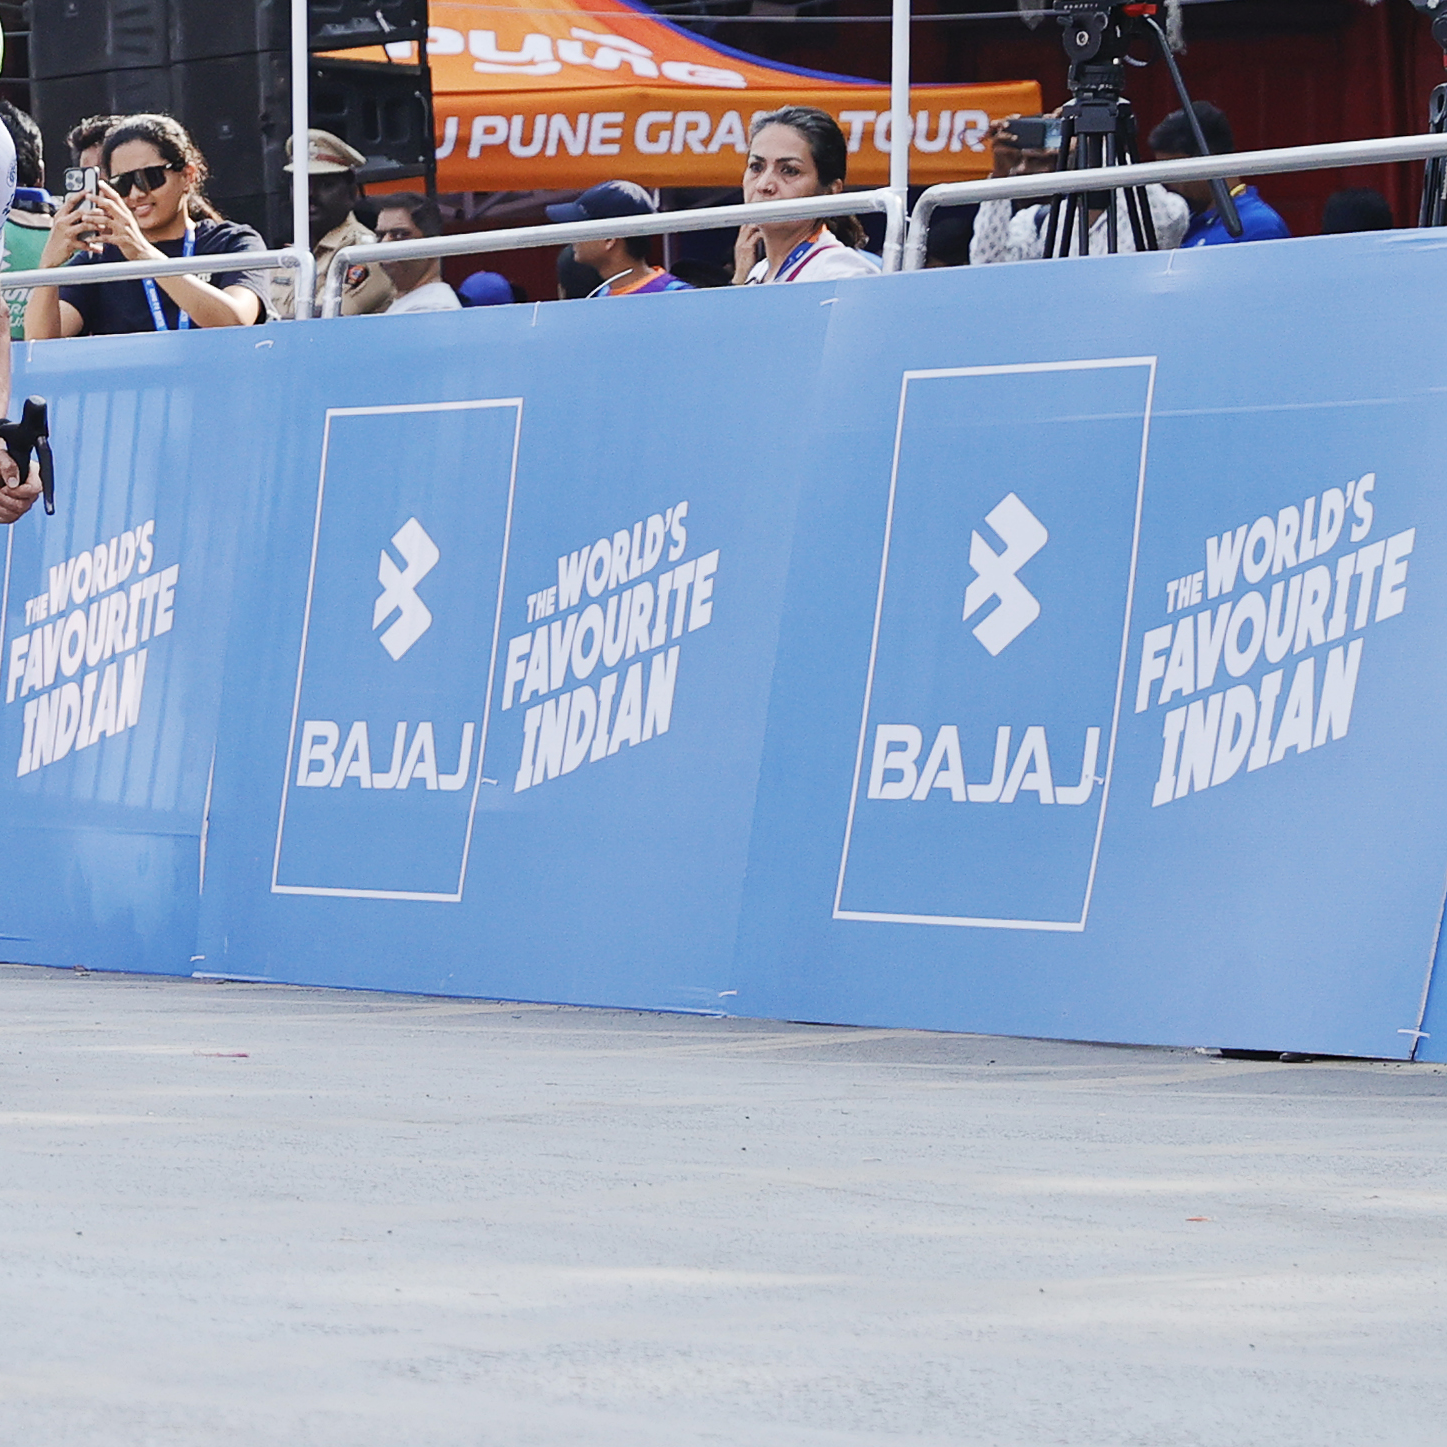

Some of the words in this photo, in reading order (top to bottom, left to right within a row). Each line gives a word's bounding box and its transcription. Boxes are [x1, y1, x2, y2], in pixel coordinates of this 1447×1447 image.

[468, 111, 624, 159] PUNE
[634, 110, 763, 155] GRA
[839, 109, 991, 153] TOUR
[24, 595, 49, 619] THE
[48, 519, 155, 611] WORLD'S
[526, 585, 557, 623] THE
[557, 500, 689, 611] WORLD'S
[1166, 570, 1205, 613] THE
[1205, 472, 1376, 600] WORLD'S
[6, 563, 180, 703] FAVOURITE
[502, 548, 720, 711] FAVOURITE
[1134, 526, 1416, 714] FAVOURITE
[17, 648, 149, 778] INDIAN
[295, 720, 475, 791] BAJAJ
[513, 645, 681, 794] INDIAN
[867, 724, 1101, 806] BAJAJ
[1151, 637, 1364, 808] INDIAN
